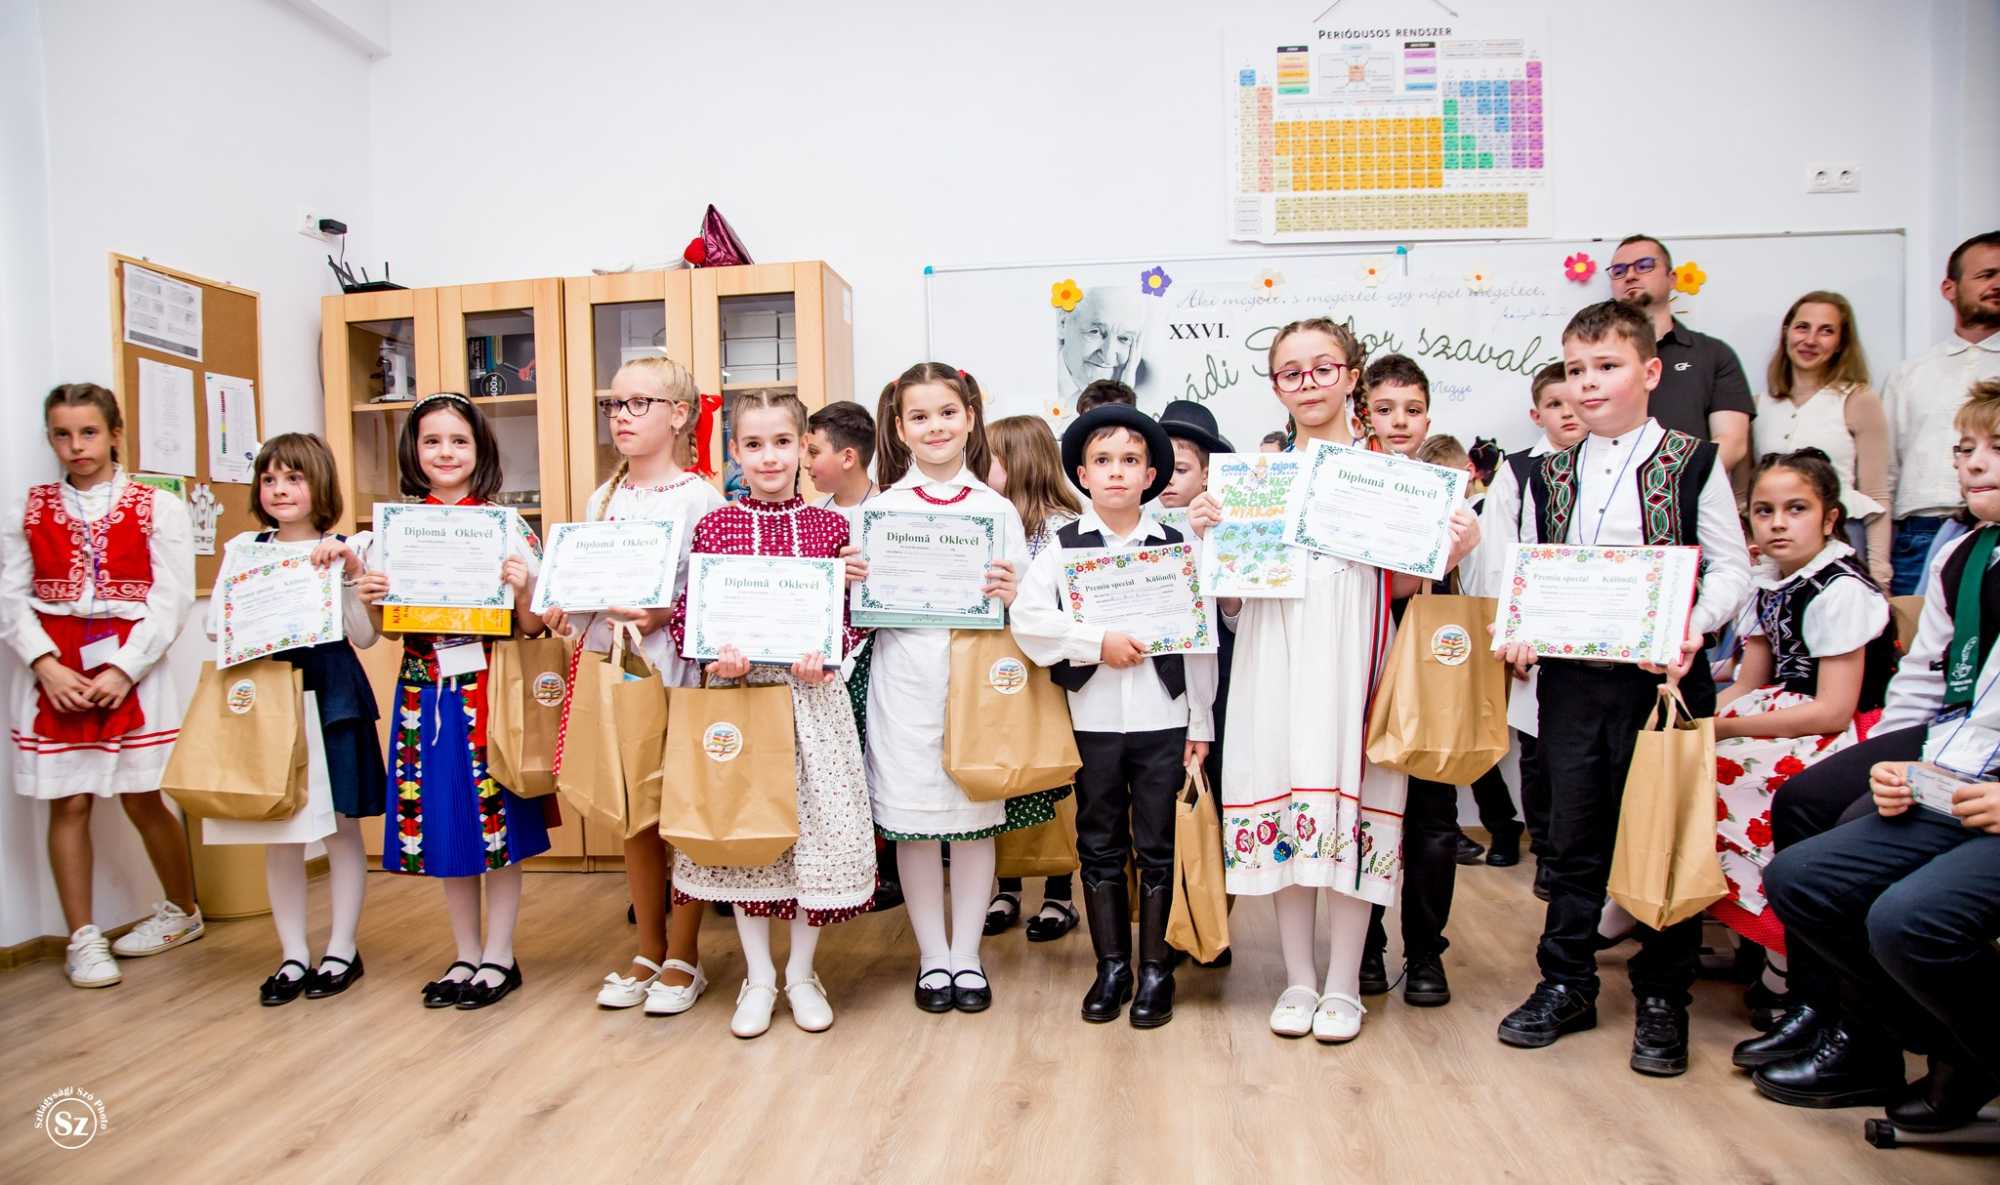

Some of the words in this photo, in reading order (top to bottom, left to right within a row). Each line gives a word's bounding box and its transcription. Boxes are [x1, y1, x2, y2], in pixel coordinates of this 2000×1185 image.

[1318, 28, 1391, 40] PERIÓDUSOS
[1396, 27, 1452, 38] RENDSZER
[1169, 323, 1230, 340] XXVI.
[940, 534, 979, 546] Oklevél
